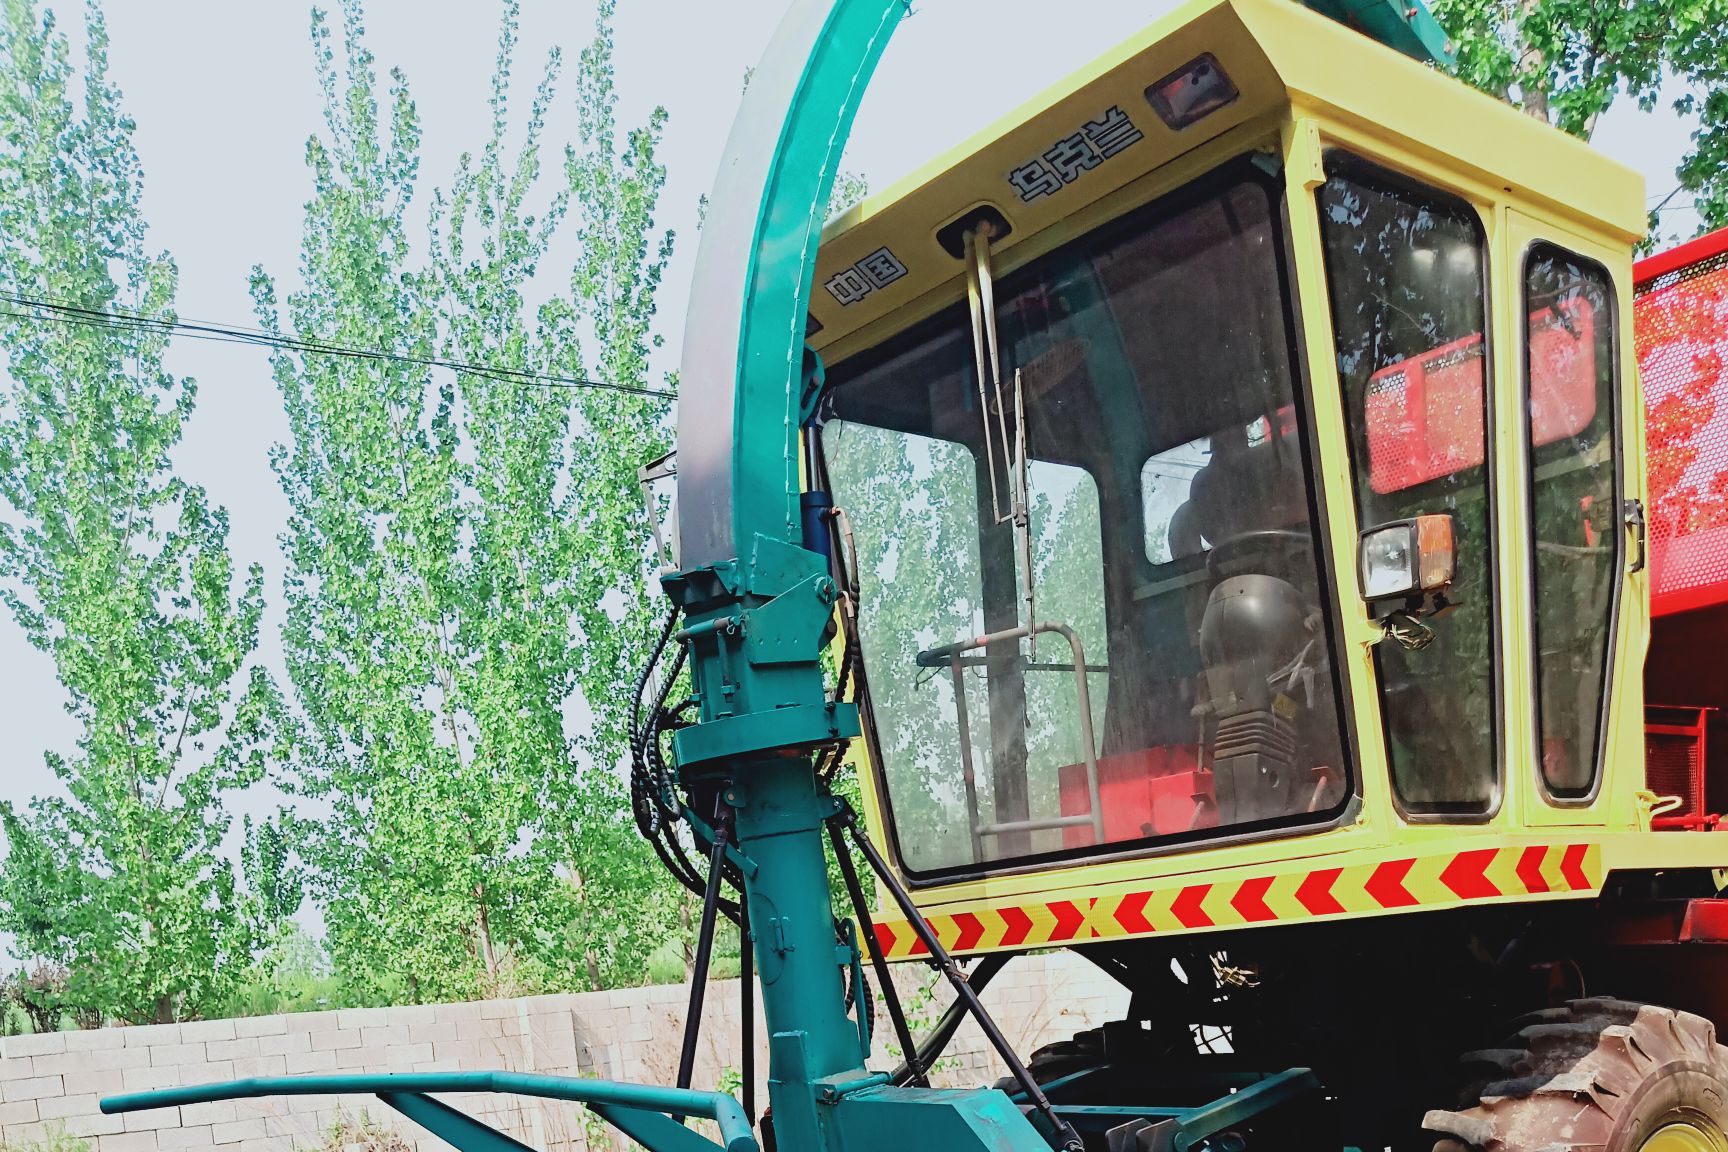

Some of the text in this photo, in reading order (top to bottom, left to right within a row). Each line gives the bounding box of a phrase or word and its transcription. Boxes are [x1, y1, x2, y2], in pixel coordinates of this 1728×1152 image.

[824, 104, 1144, 307] 中国 乌克兰
